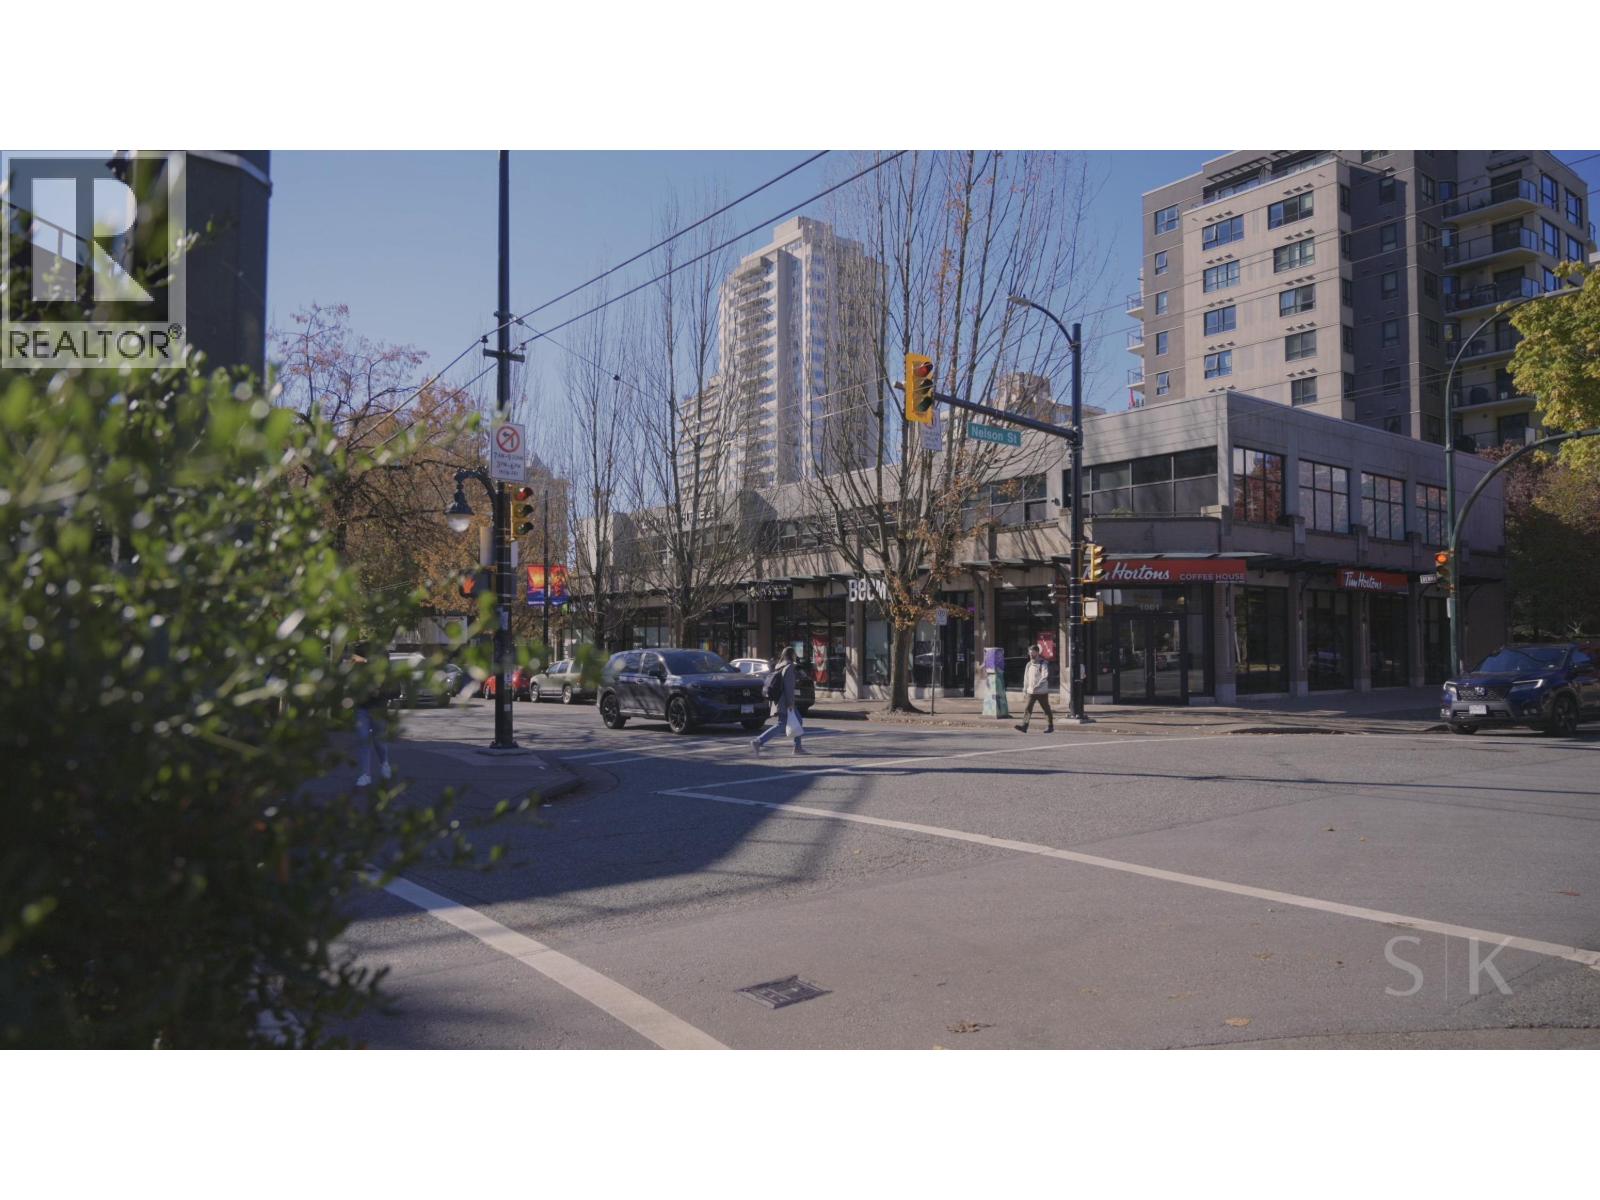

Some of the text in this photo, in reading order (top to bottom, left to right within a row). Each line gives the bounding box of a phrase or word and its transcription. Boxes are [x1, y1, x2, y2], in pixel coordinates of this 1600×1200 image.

[971, 425, 1017, 444] Nelson St
[1112, 562, 1170, 580] Hortons
[1179, 573, 1214, 581] COFFEE
[1215, 573, 1245, 581] HOUSE
[1344, 571, 1382, 589] Tim Hortons
